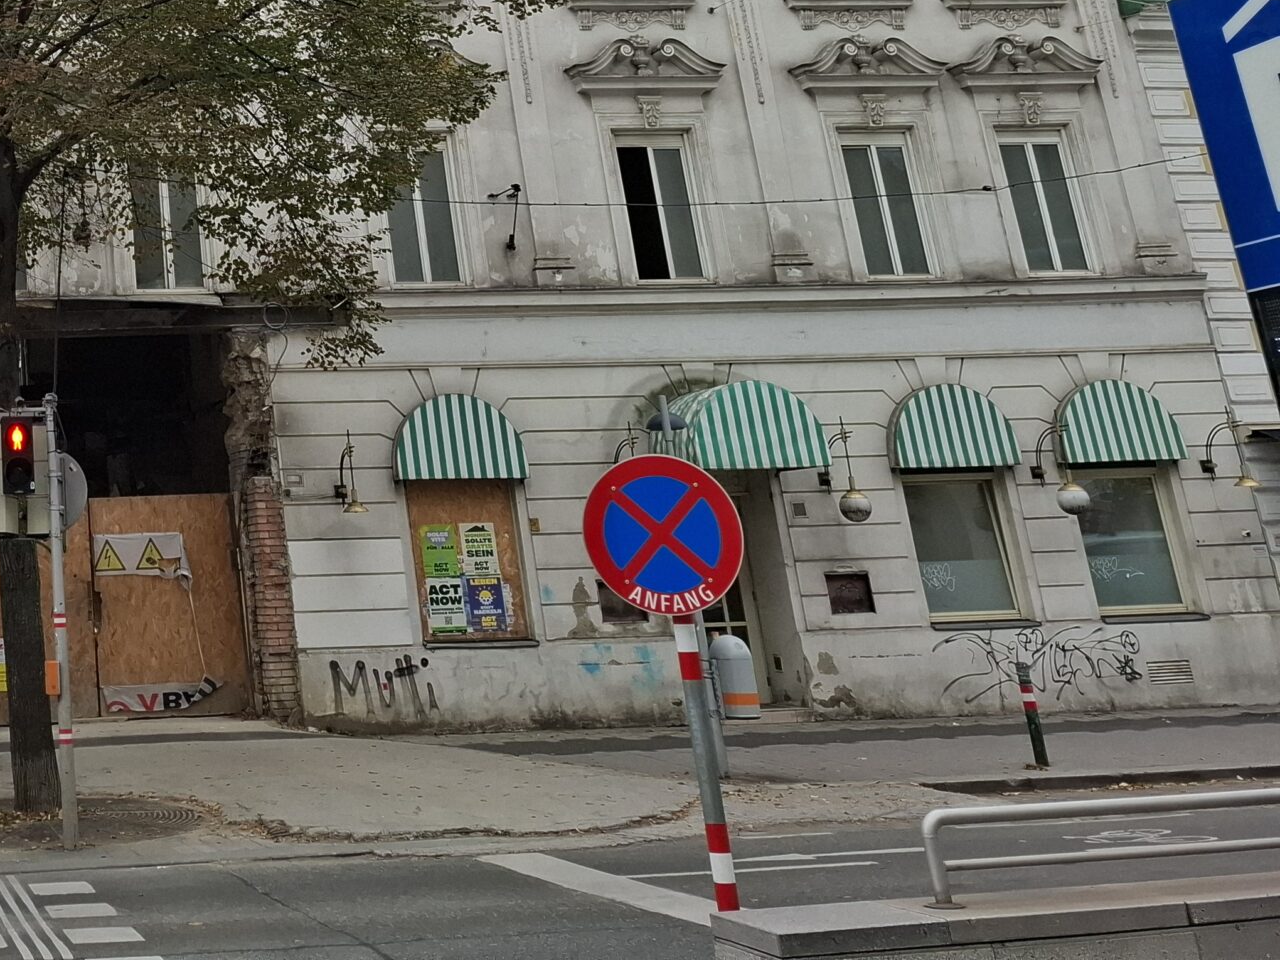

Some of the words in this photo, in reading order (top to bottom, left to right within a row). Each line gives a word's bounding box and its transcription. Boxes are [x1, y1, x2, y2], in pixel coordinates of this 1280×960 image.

[467, 549, 494, 558] SEIN
[429, 584, 461, 596] ACT
[429, 596, 463, 606] NOW
[628, 584, 715, 612] ANFANG
[329, 654, 441, 720] Mutti
